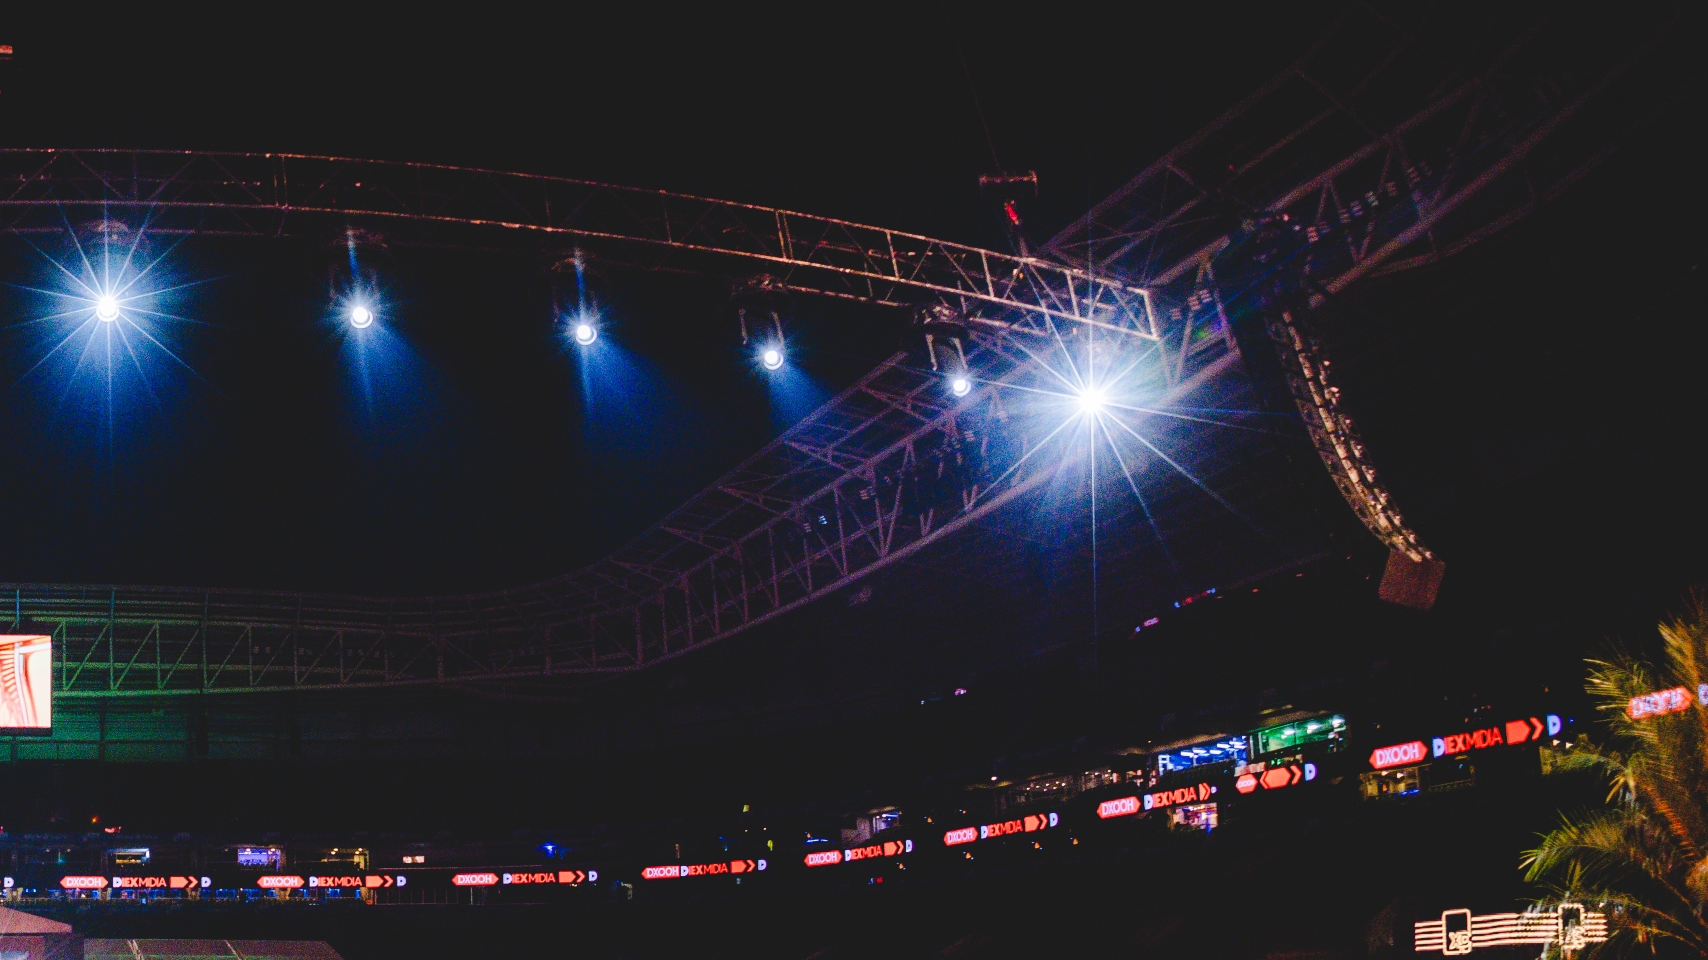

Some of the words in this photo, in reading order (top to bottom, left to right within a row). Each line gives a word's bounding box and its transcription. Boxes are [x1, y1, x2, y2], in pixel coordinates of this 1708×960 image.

[66, 877, 102, 887] DXOOH
[263, 876, 298, 886] DXOOH
[457, 874, 492, 884] DXOOH
